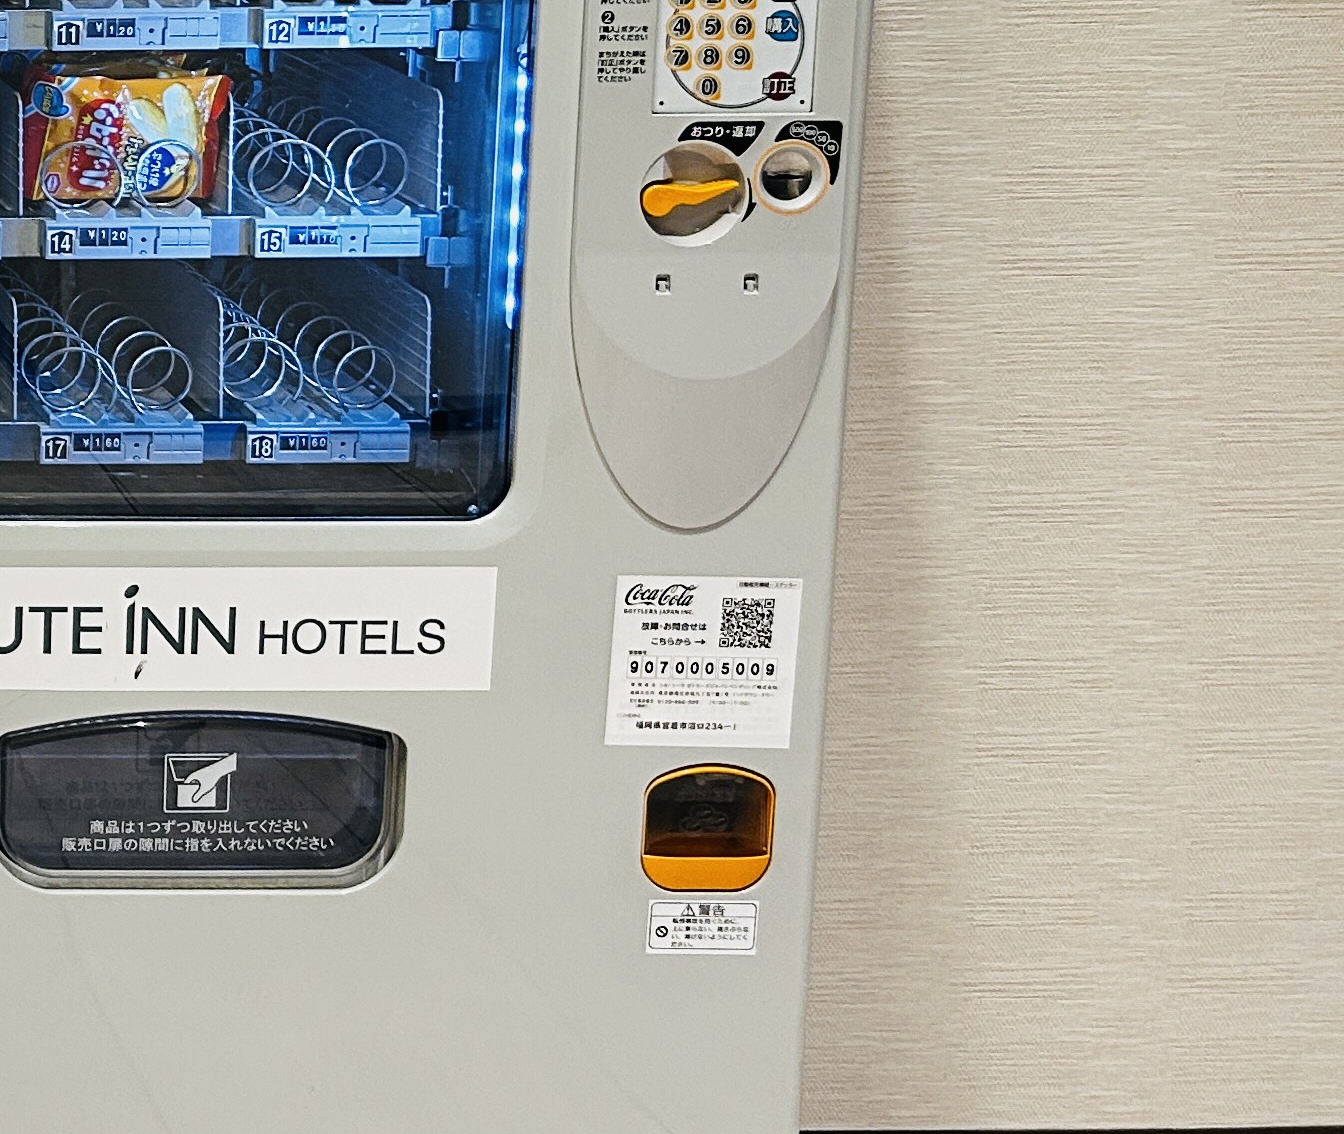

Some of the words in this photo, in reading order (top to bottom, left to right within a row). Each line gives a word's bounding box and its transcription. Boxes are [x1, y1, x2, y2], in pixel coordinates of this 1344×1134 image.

[269, 24, 289, 42] 12
[673, 19, 684, 35] 4
[705, 19, 716, 35] 5
[735, 18, 747, 35] 6
[766, 17, 799, 33] 購入
[59, 25, 79, 44] 11
[672, 50, 683, 67] 7
[703, 49, 714, 65] 8
[734, 48, 745, 65] 9
[702, 79, 712, 96] 0
[763, 78, 795, 94] 訂正
[691, 126, 756, 137] おつり・返却
[78, 102, 121, 189] ハッピーターン
[52, 232, 70, 251] 14
[262, 232, 280, 251] 15
[47, 440, 65, 458] 17
[253, 439, 271, 456] 18
[625, 584, 697, 606] Coca-Cola
[641, 623, 707, 631] 故障・お問合せは
[259, 619, 446, 655] HOTELS
[90, 820, 308, 834] 商品は1つずつ取り出してください
[62, 837, 335, 852] 販売口扉の隙間に指を入れないでください
[698, 904, 725, 916] 警告
